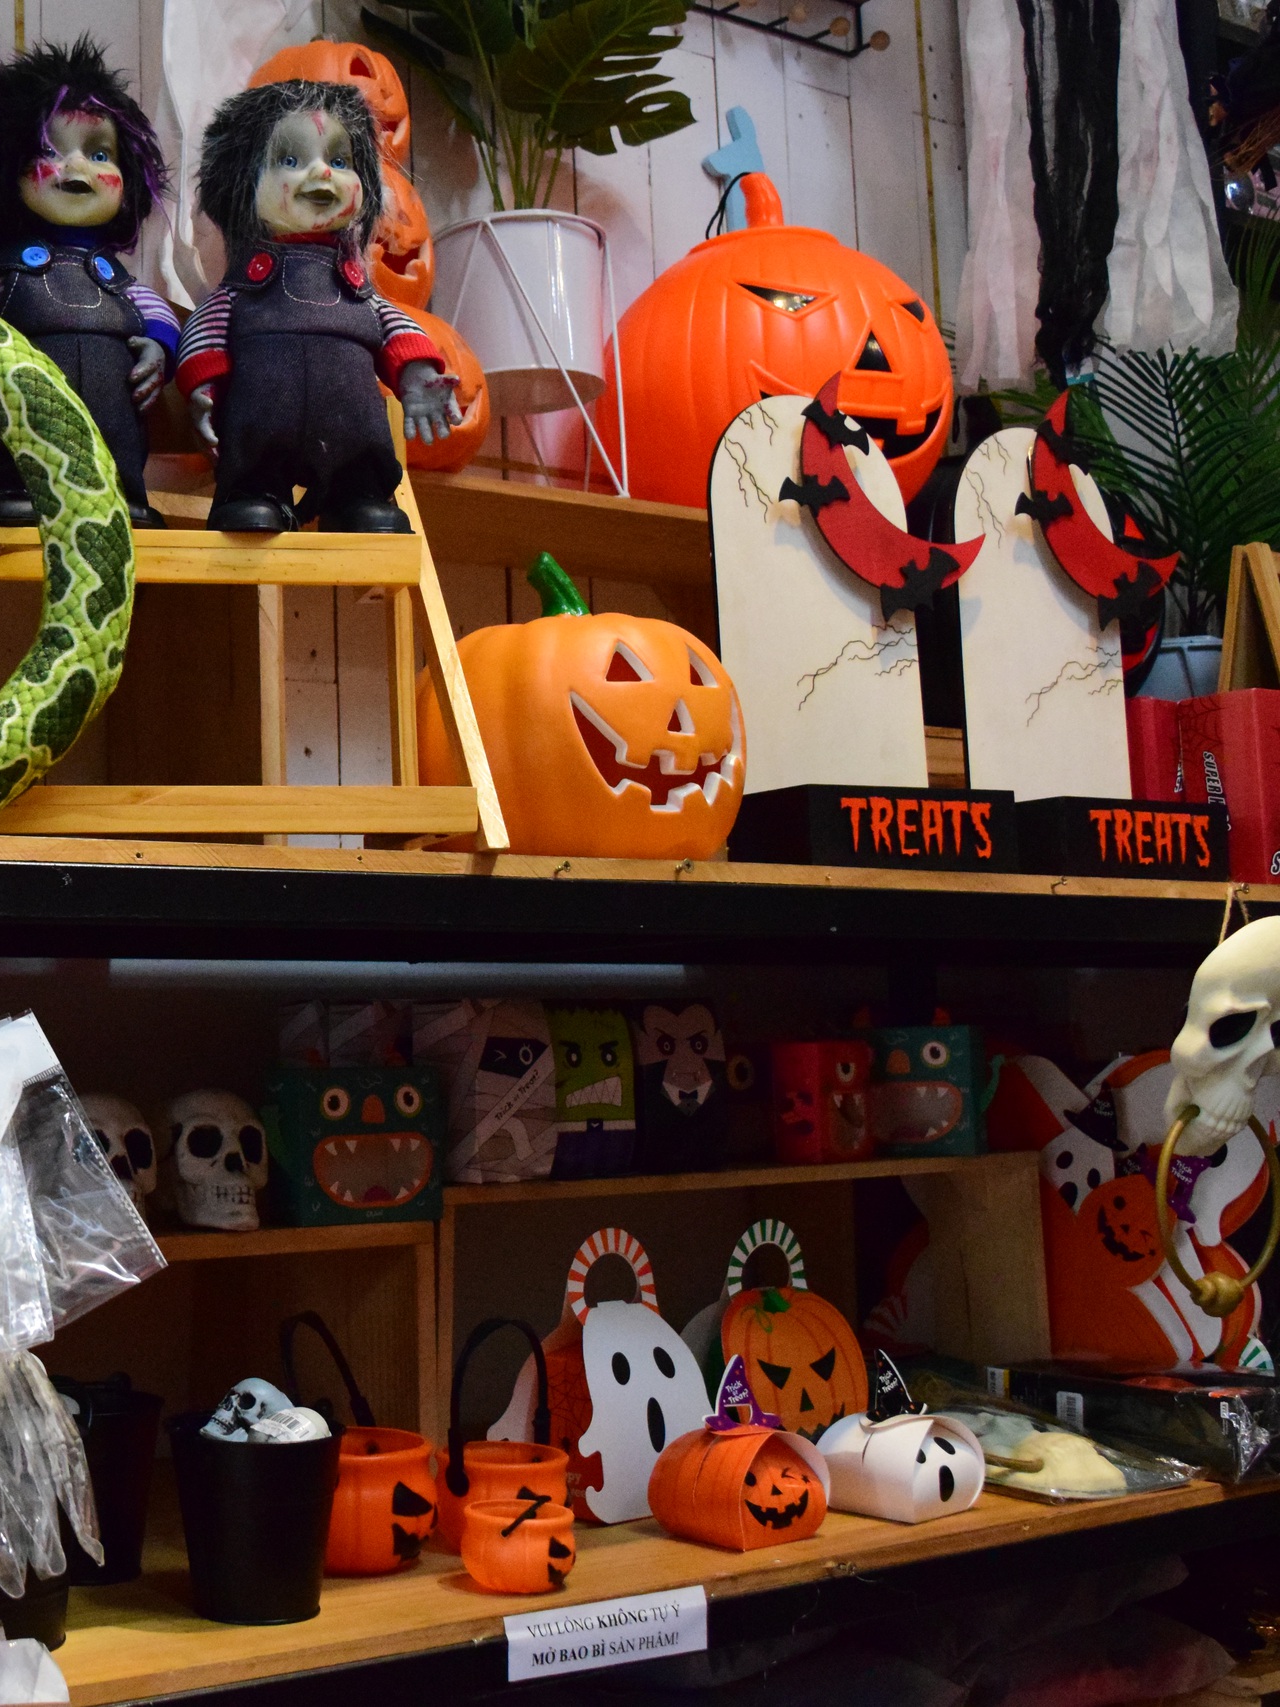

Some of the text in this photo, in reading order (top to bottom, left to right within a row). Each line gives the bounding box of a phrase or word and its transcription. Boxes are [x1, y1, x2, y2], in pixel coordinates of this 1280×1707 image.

[1203, 751, 1223, 795] SUPER
[840, 796, 992, 859] TREATS
[1088, 808, 1211, 868] TREATS
[1172, 1166, 1193, 1185] Treat?
[1176, 1159, 1193, 1175] Trick
[879, 1370, 893, 1383] Trick
[882, 1377, 898, 1393] Treat?
[725, 1380, 743, 1393] Trick
[728, 1388, 749, 1404] Treat?
[527, 1600, 680, 1637] VUI LÒNG KHÔNG TỰ Ý
[532, 1646, 556, 1666] MỞ
[560, 1646, 588, 1662] BAO
[592, 1639, 605, 1658] BÌ
[609, 1636, 635, 1655] SẢN
